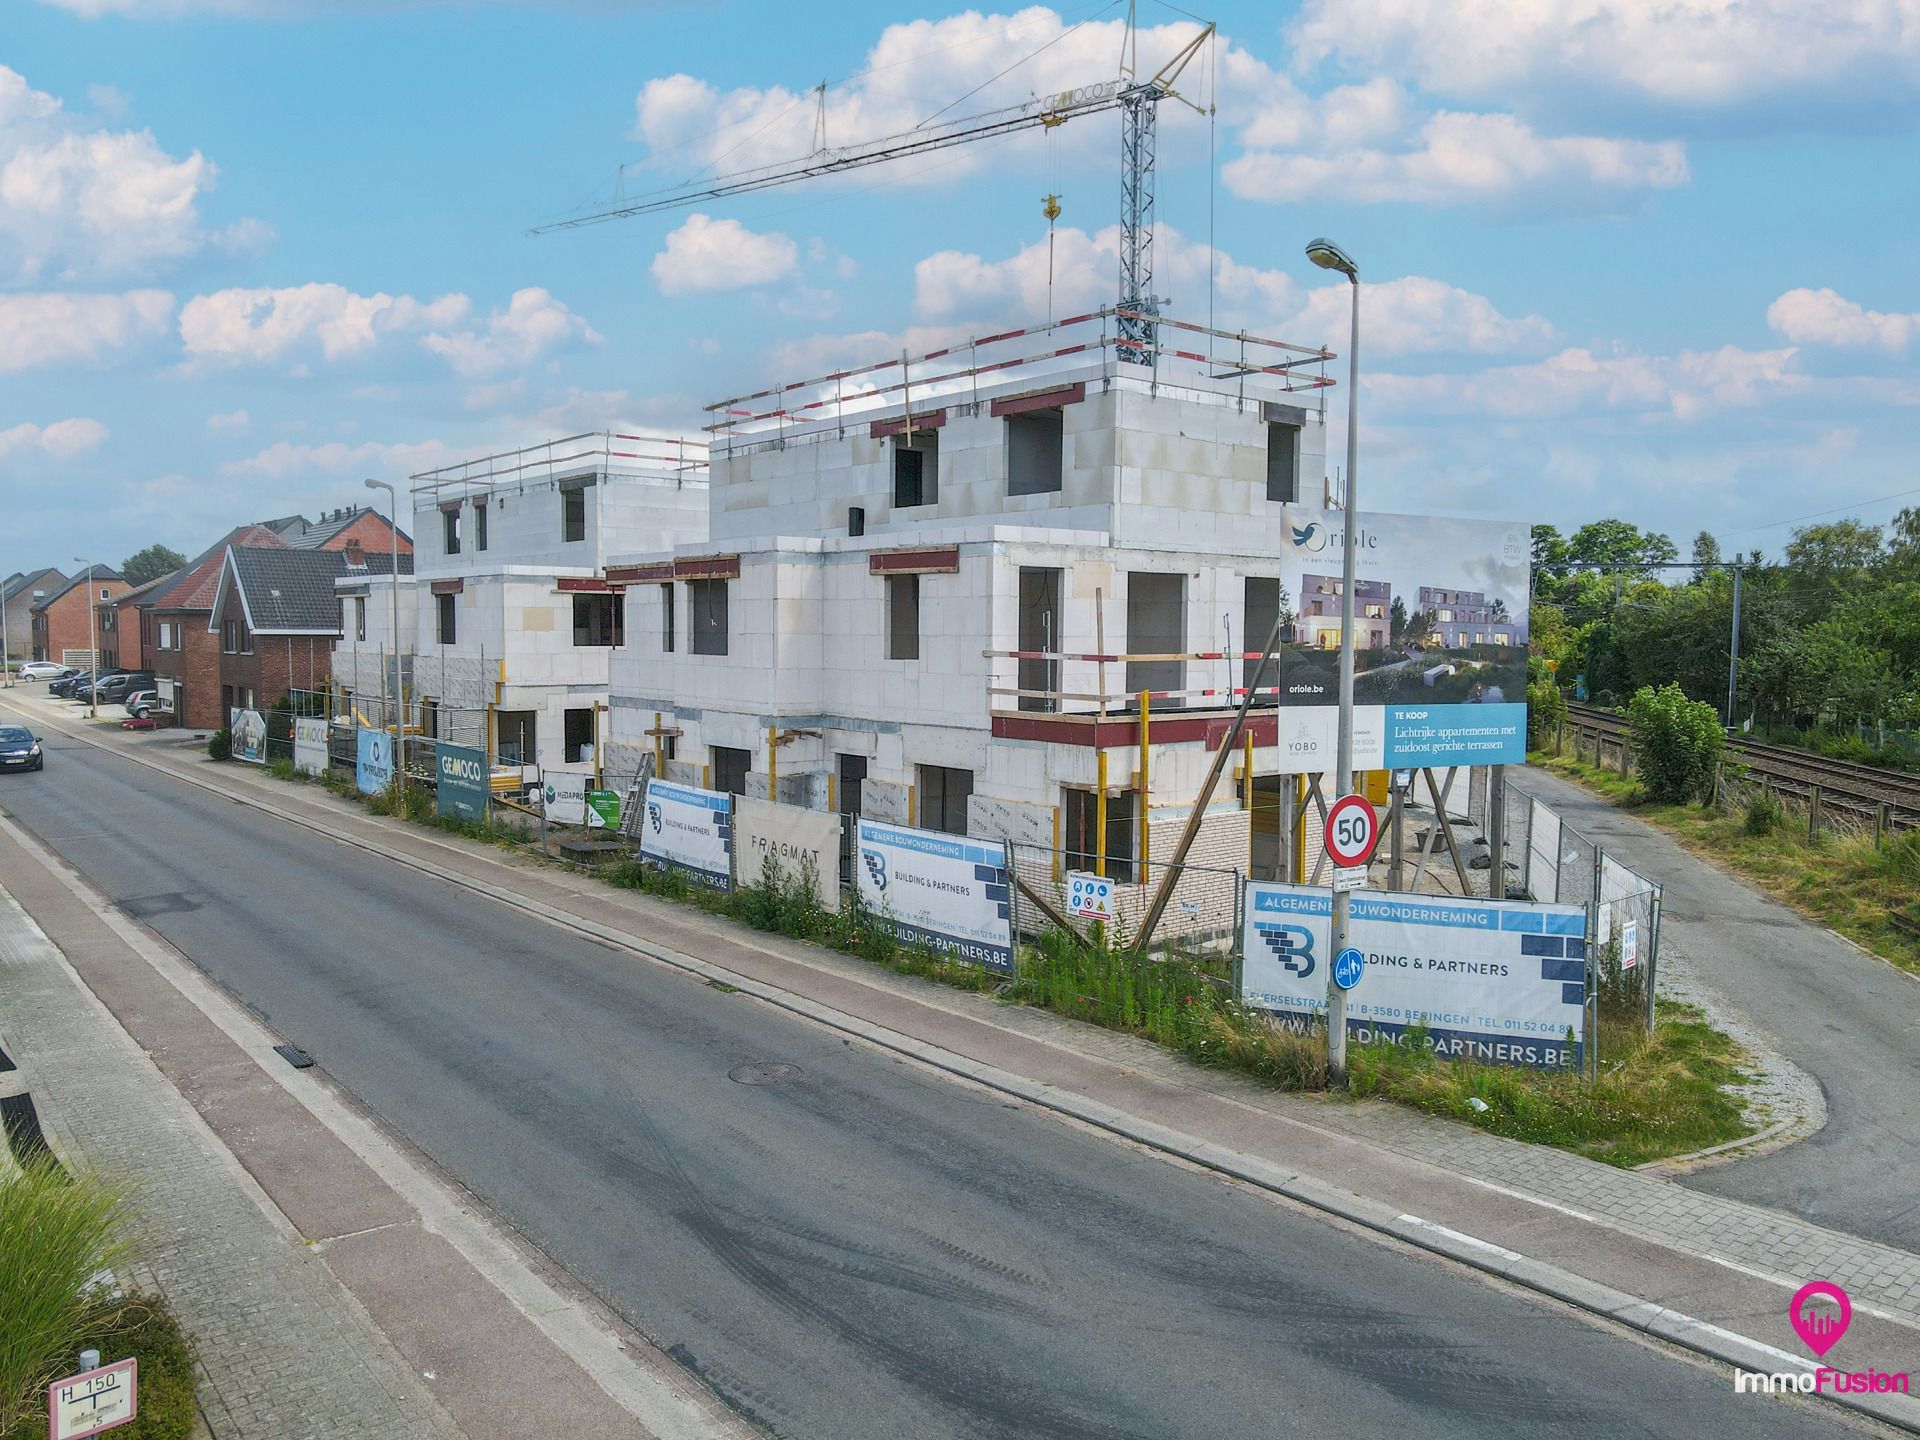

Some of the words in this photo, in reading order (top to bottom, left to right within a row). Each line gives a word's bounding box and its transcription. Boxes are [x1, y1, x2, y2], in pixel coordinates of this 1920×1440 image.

[1289, 684, 1324, 694] oriole.be
[1395, 712, 1404, 720] TE
[1405, 711, 1429, 720] KOOP
[1394, 726, 1436, 741] Lichtrijke
[1437, 727, 1499, 740] appartementen
[1501, 726, 1517, 735] met
[1288, 742, 1318, 752] YOBO
[1394, 741, 1430, 753] zuidoost
[1432, 740, 1466, 754] gerichte
[1467, 741, 1503, 750] terrassen
[442, 755, 481, 782] GEMOCO
[687, 825, 710, 836] PARTNERS
[1338, 816, 1366, 847] 50
[751, 835, 820, 864] FRAGMAT
[894, 871, 926, 887] BUILDING
[926, 878, 932, 888] &
[932, 880, 971, 897] PARTNERS
[1264, 896, 1333, 913] ALGEMENE
[1349, 903, 1488, 924] OUWONDERNEMING
[1361, 952, 1408, 968] LDING
[1413, 958, 1423, 969] &
[1428, 959, 1509, 977] PARTNERS
[1360, 1004, 1401, 1018] B-3580
[1405, 1009, 1470, 1025] BERINGEN
[1504, 1019, 1521, 1030] 011
[1524, 1021, 1537, 1032] 52
[1540, 1023, 1555, 1033] 04
[62, 1386, 73, 1402] H
[86, 1373, 115, 1394] 150
[96, 1416, 103, 1425] 5
